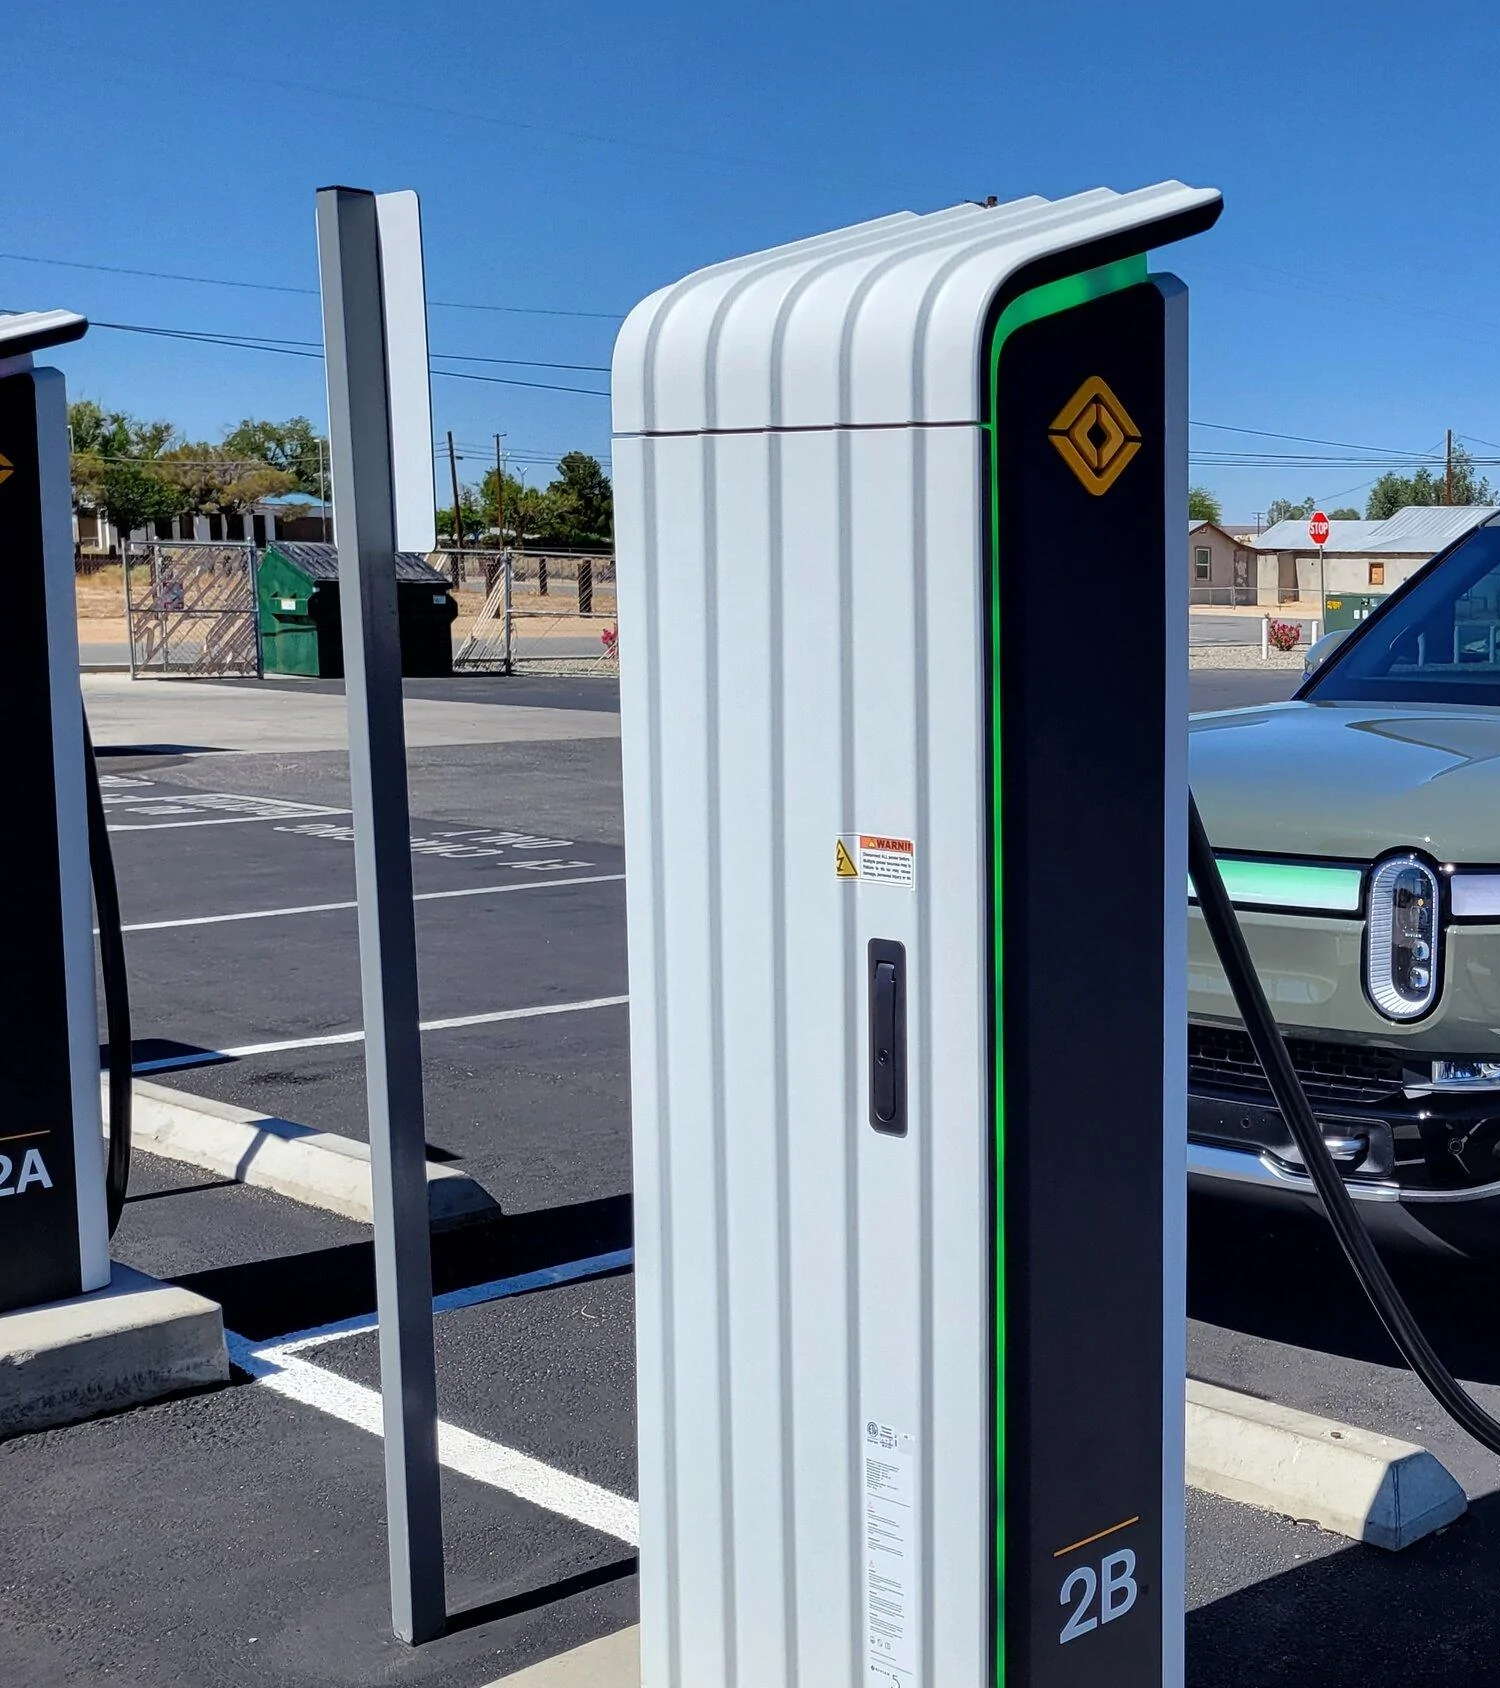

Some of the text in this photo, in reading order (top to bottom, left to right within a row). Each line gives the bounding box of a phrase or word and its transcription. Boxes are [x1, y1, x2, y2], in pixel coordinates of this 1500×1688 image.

[1310, 521, 1328, 535] STOP
[431, 829, 574, 849] ONLY
[876, 839, 911, 851] WARNI
[497, 859, 596, 871] EV
[0, 1148, 54, 1197] 2A
[1060, 1548, 1138, 1645] 2B
